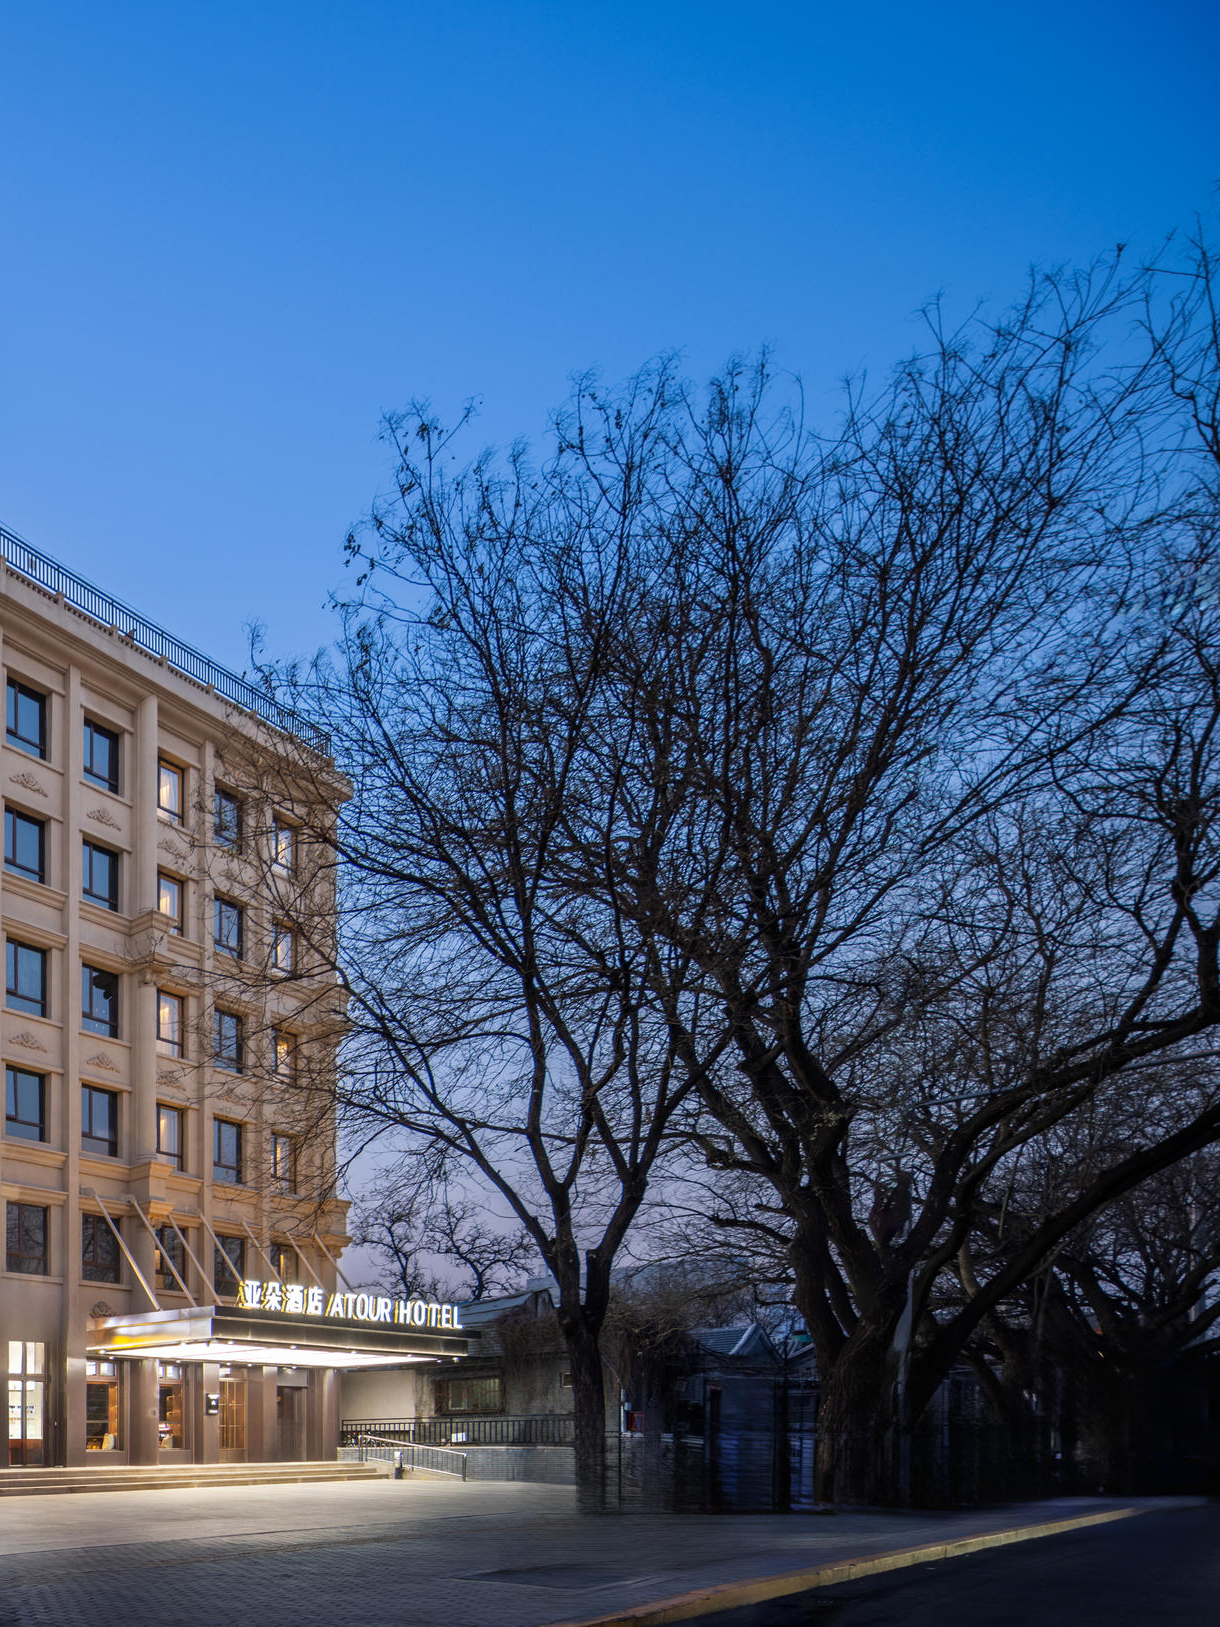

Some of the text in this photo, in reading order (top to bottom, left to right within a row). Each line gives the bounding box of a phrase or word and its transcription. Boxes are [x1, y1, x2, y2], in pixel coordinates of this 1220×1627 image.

[243, 1279, 464, 1329] 亚朵酒店 ATOUR HOTEL
